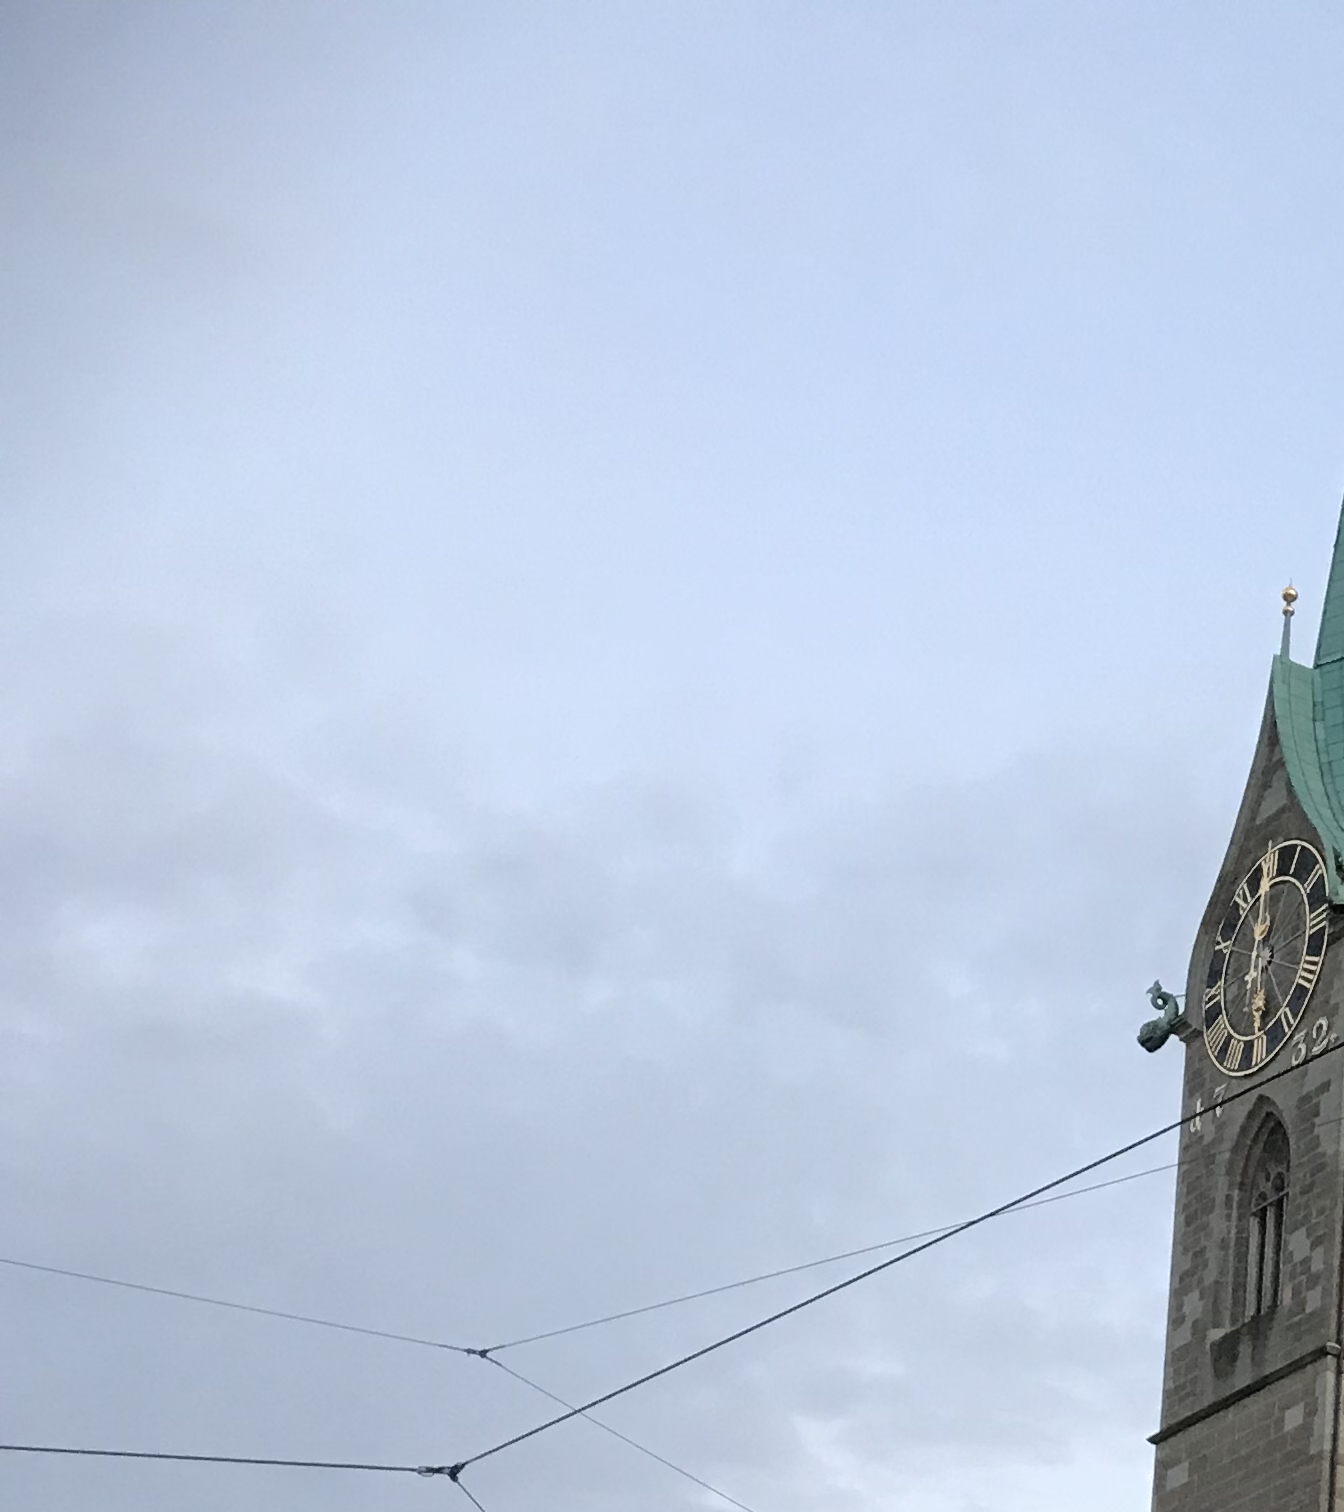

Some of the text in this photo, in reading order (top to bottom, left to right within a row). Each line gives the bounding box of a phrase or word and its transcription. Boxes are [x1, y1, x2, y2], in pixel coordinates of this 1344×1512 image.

[1288, 844, 1302, 876] I
[1303, 863, 1323, 894] II
[1309, 903, 1329, 935] III
[1297, 955, 1321, 989] IIII
[1280, 1006, 1295, 1034] V
